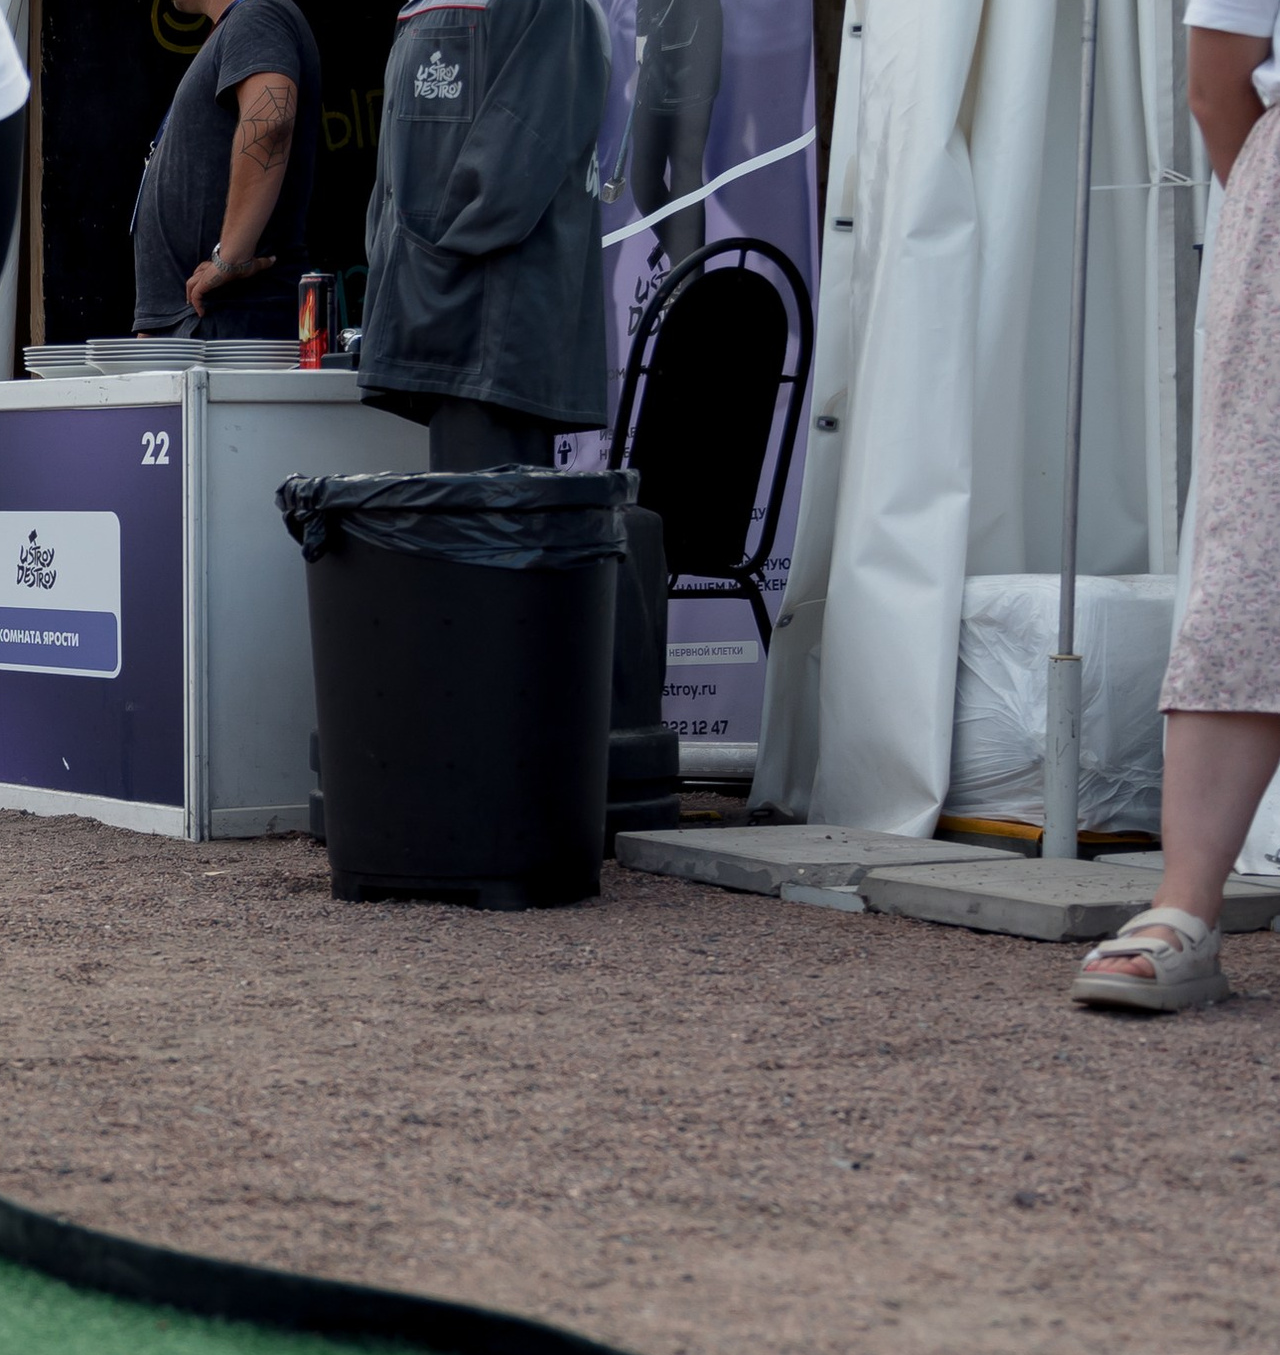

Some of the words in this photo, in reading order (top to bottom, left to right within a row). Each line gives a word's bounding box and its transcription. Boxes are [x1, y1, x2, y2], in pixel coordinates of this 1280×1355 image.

[413, 80, 463, 99] DESTROY
[141, 431, 170, 465] 22
[20, 545, 55, 567] USTROY
[16, 564, 57, 590] DESTROY
[43, 631, 79, 647] ЯРОСТИ
[669, 646, 710, 657] НЕРВНОЙ
[711, 646, 743, 656] КЛЕТКИ
[662, 683, 716, 700] stroy.ru
[692, 720, 708, 735] 12
[711, 720, 728, 735] 47
